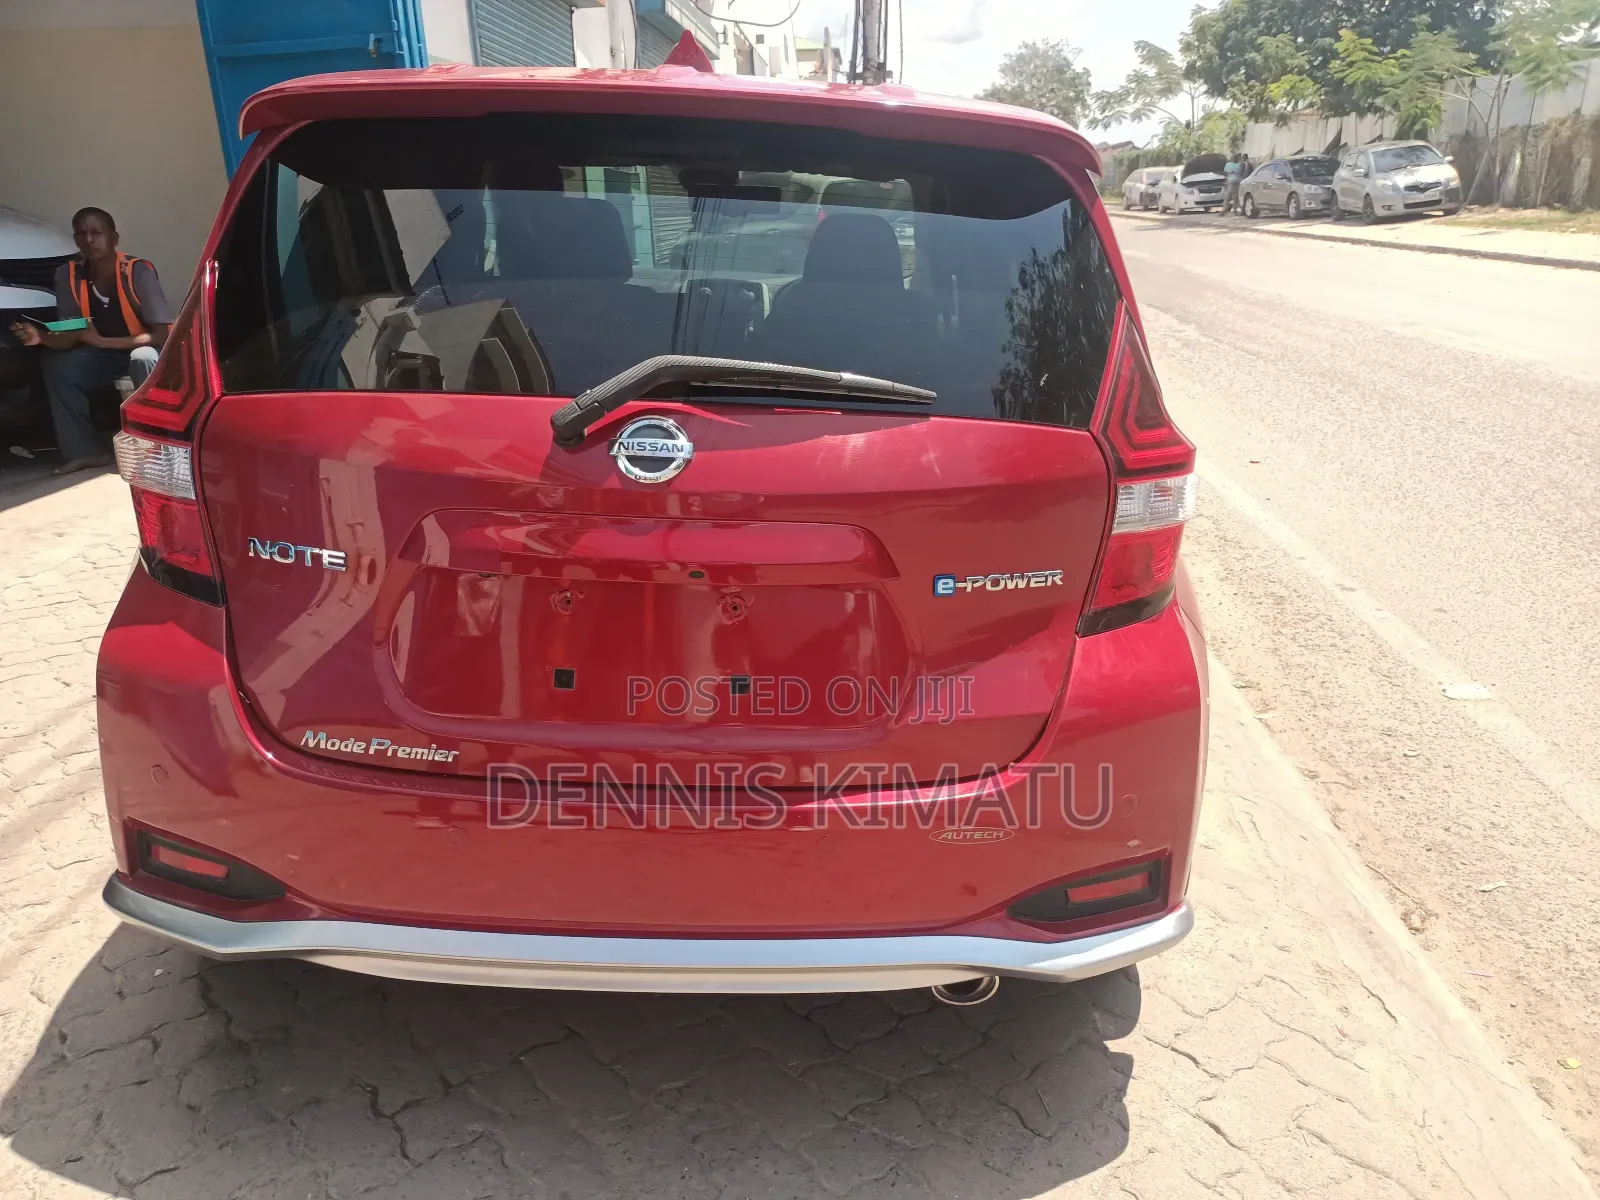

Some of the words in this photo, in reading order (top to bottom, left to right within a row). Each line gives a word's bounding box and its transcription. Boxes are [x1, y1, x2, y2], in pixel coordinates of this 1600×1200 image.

[618, 441, 684, 454] NISSAN
[248, 537, 348, 571] NOTE
[933, 570, 1064, 597] e-POWER
[937, 830, 1005, 840] AUTECH
